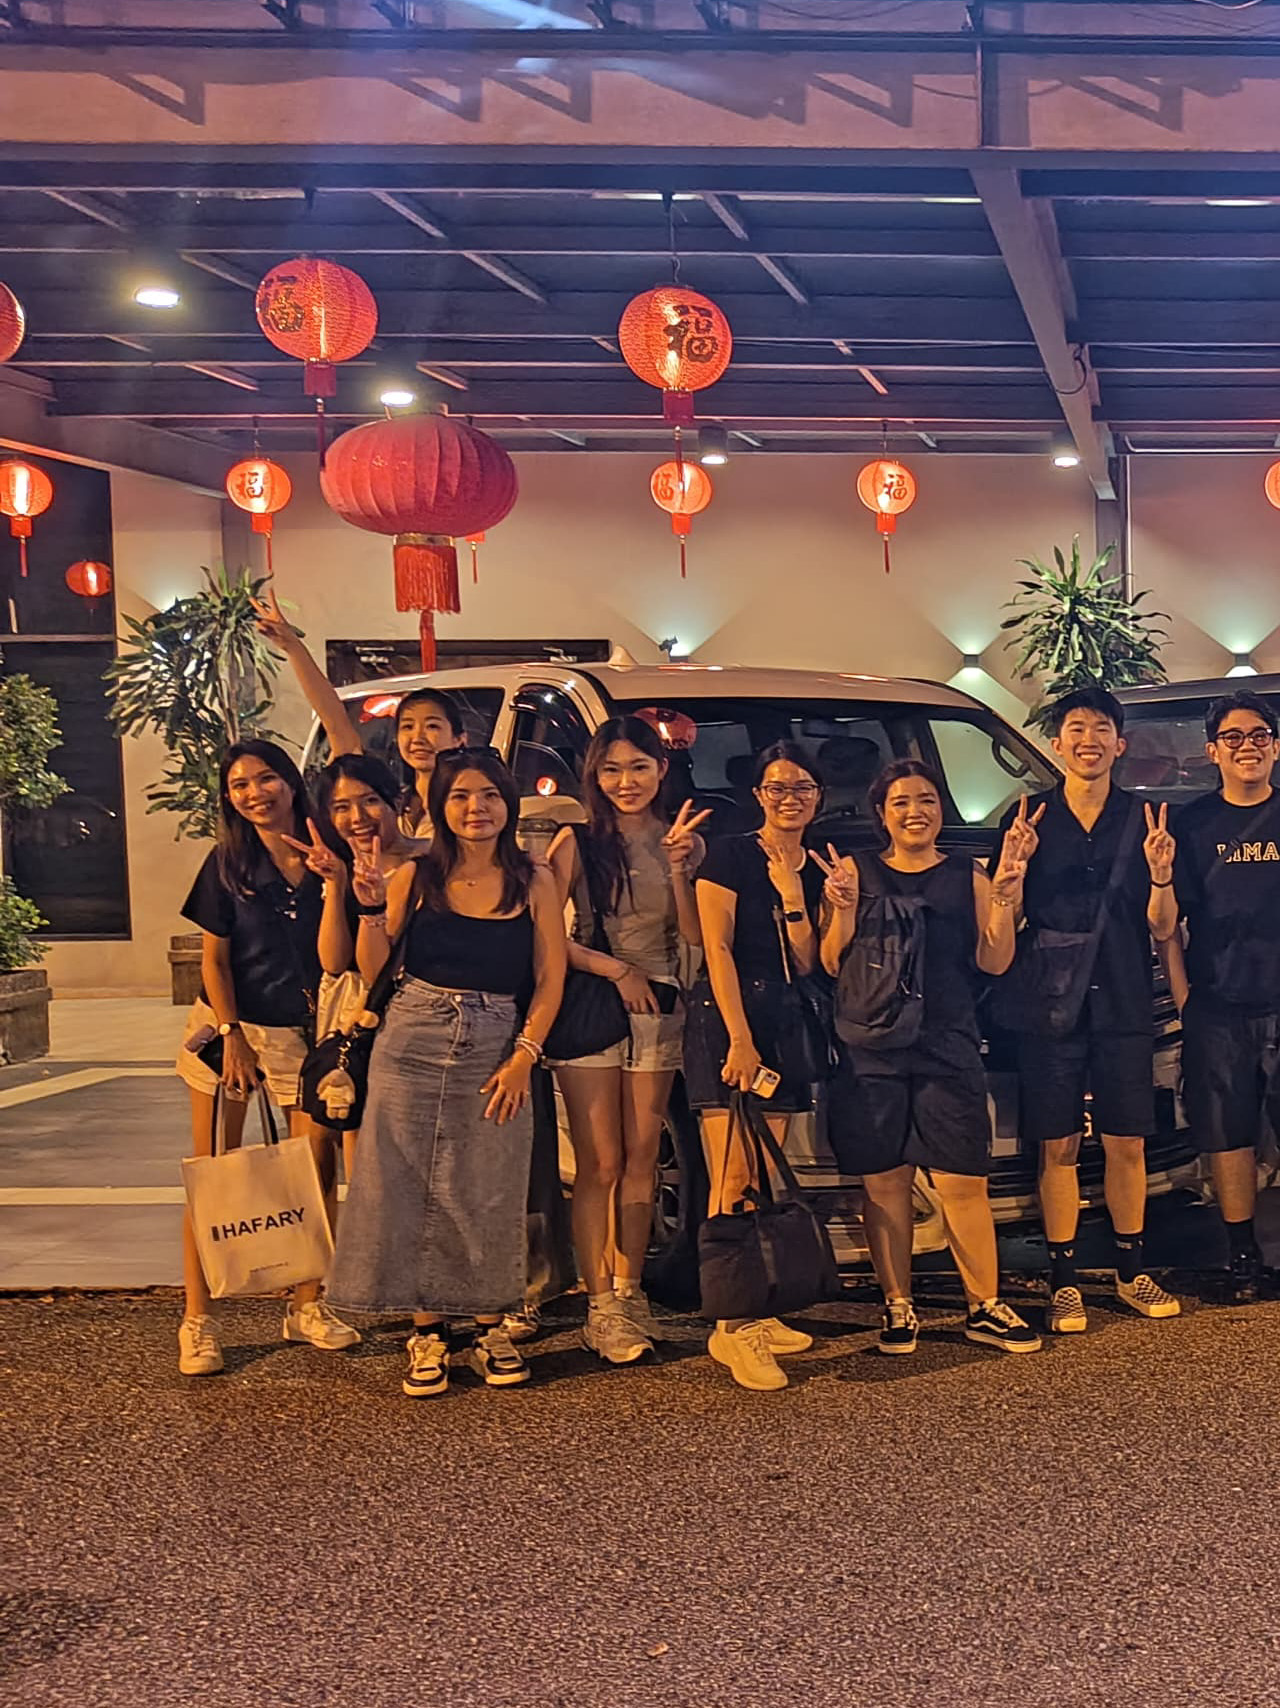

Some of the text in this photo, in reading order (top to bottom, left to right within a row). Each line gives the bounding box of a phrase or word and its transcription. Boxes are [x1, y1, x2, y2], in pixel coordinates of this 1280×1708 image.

[663, 305, 718, 363] 福
[883, 473, 908, 500] 福
[222, 1207, 305, 1239] HAFARY
